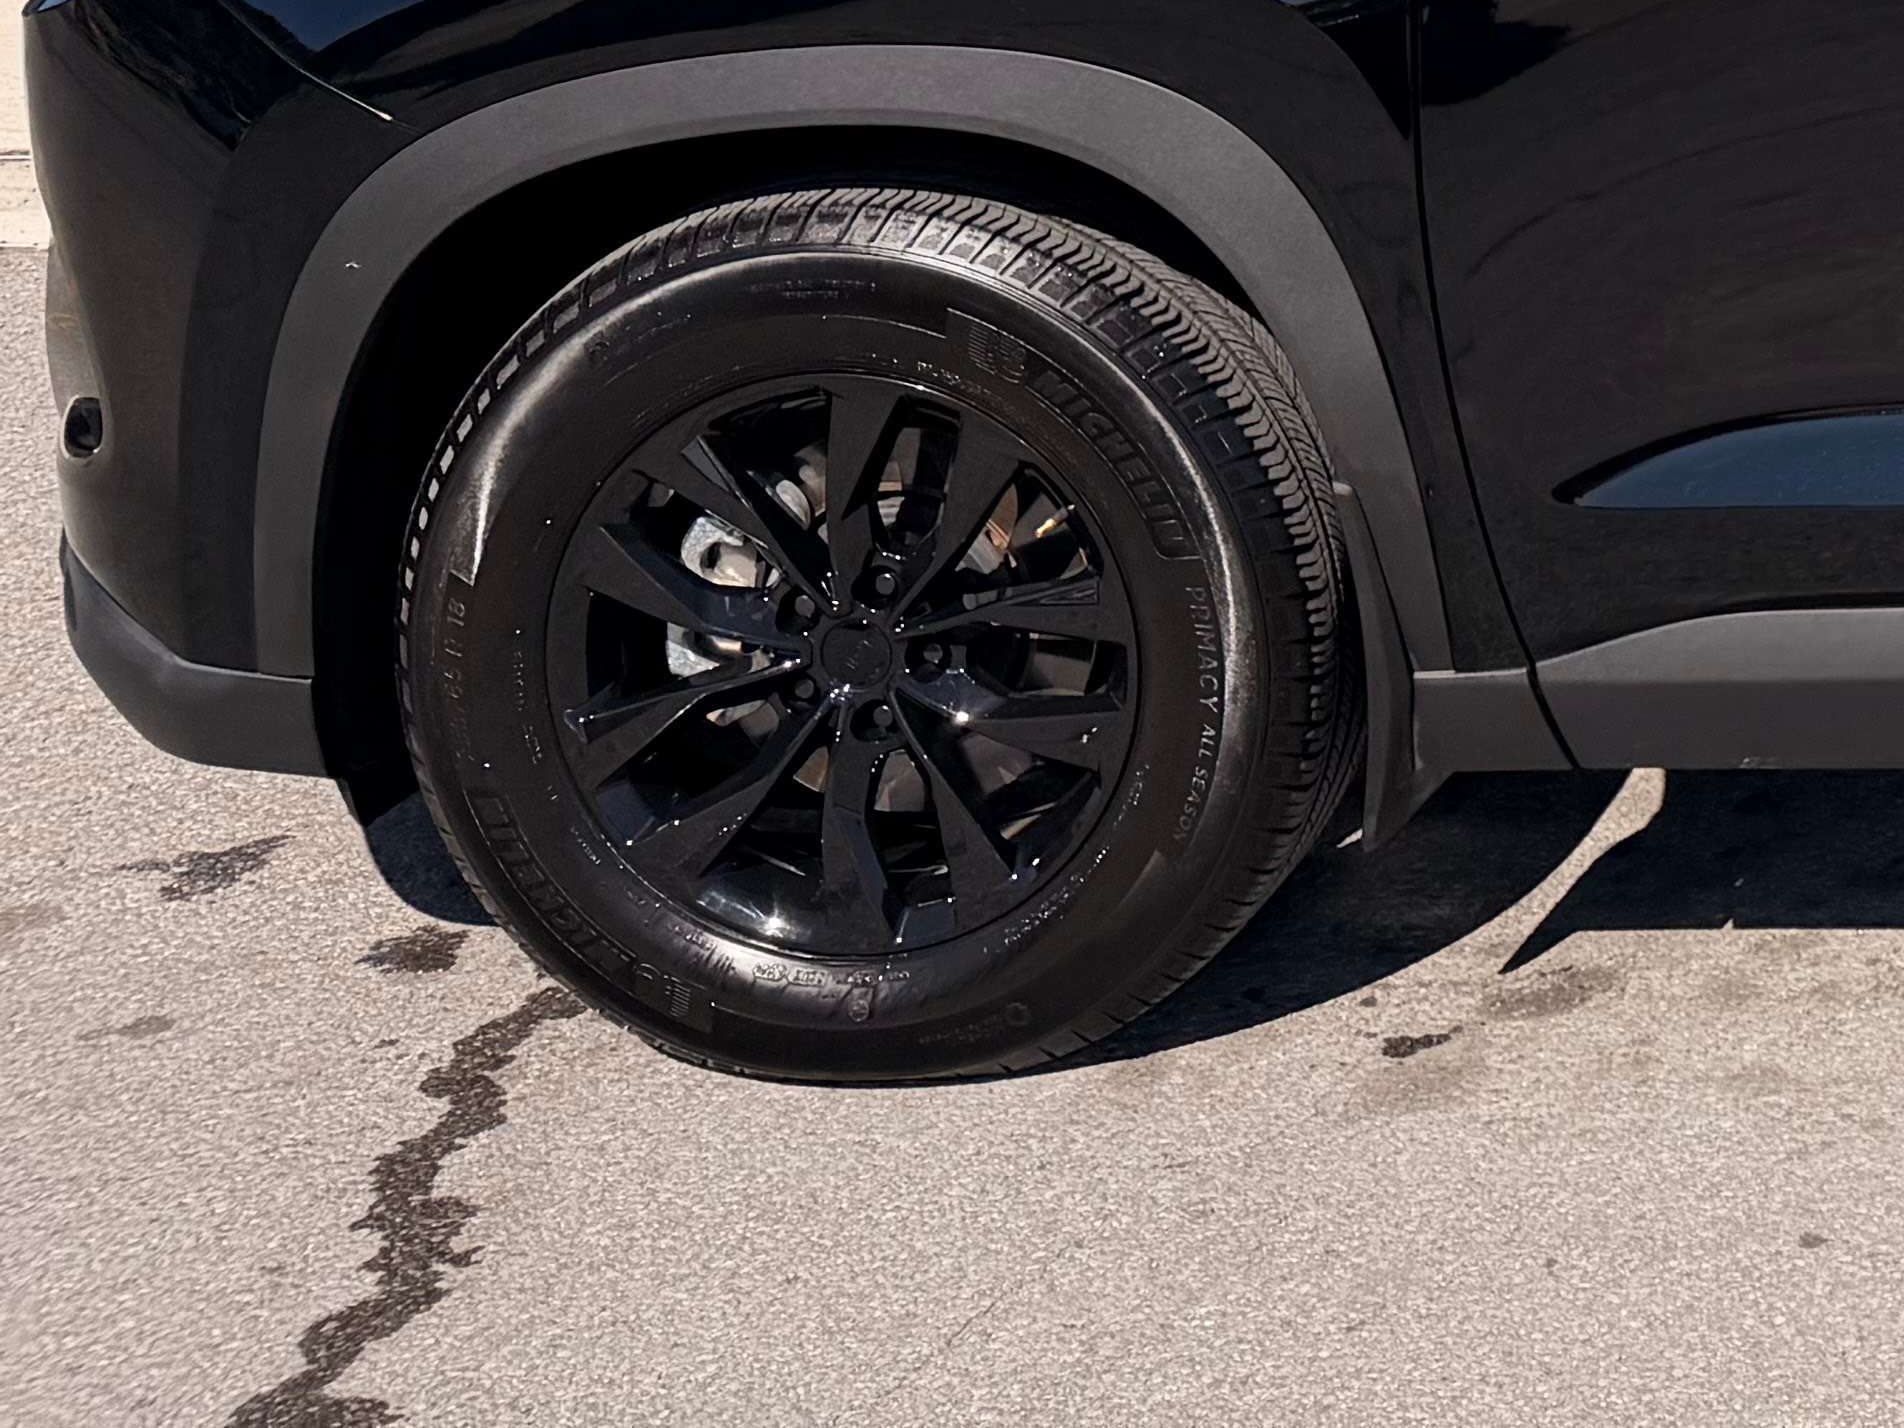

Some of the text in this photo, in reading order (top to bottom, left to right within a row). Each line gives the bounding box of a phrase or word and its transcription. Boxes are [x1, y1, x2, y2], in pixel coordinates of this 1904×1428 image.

[1034, 366, 1199, 556] MICHELIN
[1171, 585, 1220, 841] PRIMACY ALL SEASON
